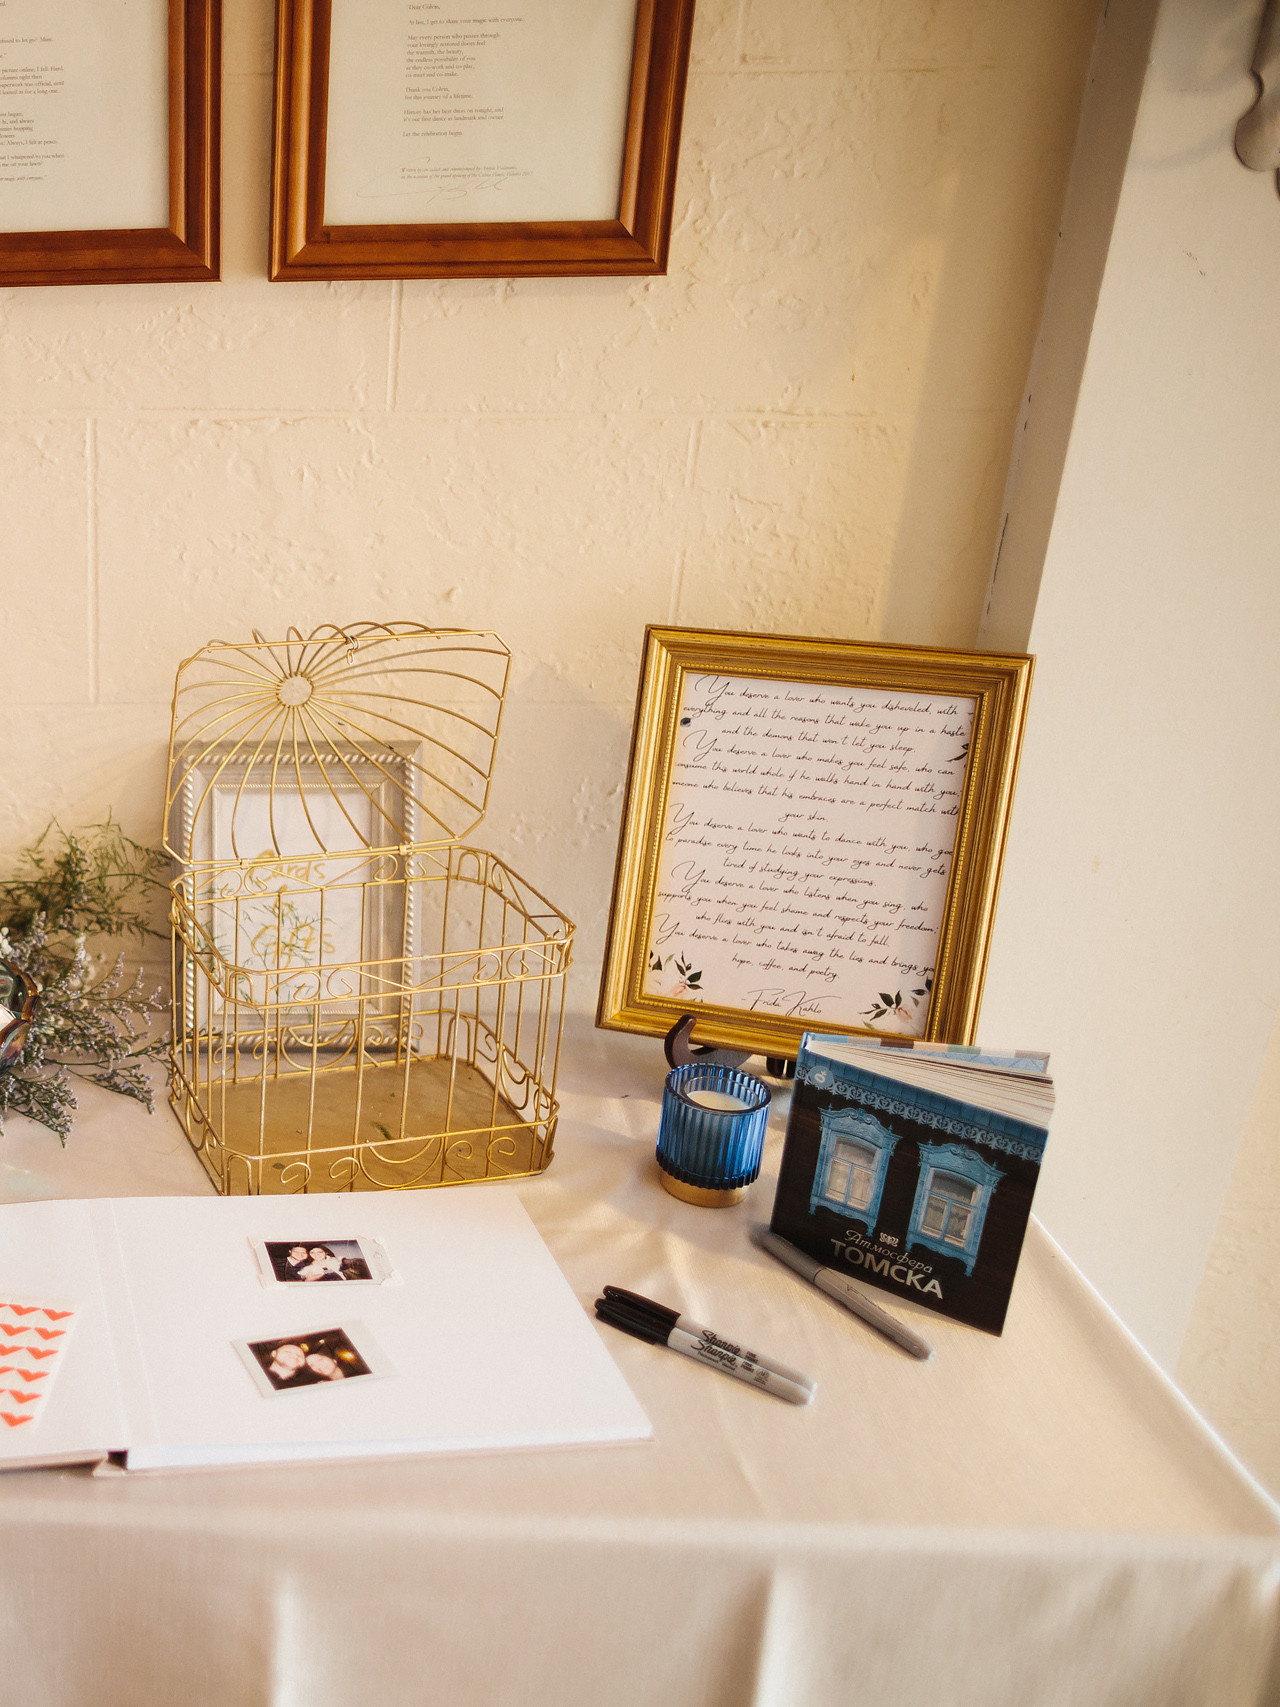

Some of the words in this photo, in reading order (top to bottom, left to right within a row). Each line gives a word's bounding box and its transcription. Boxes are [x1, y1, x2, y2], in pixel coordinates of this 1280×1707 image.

[694, 675, 735, 708] You
[739, 687, 770, 699] deserve
[784, 690, 804, 701] lover
[809, 693, 826, 704] who
[830, 696, 854, 708] wants
[853, 702, 875, 714] you
[881, 699, 932, 715] disheveled,
[936, 705, 958, 715] with
[683, 704, 728, 720] everything
[732, 706, 750, 716] and
[753, 708, 769, 719] all
[771, 710, 786, 720] the
[790, 715, 819, 724] reasons
[825, 713, 845, 726] that
[849, 717, 871, 728] wake
[868, 723, 893, 734] you
[897, 726, 910, 736] up
[940, 724, 966, 737] haste
[683, 729, 721, 762] You
[727, 744, 757, 756] deserve
[771, 748, 792, 759] lover
[796, 750, 813, 762] who
[816, 753, 843, 765] makes
[841, 760, 865, 771] you
[864, 757, 888, 770] feel
[889, 760, 910, 773] safe,
[915, 762, 933, 774] who
[937, 768, 956, 776] can
[721, 725, 742, 735] and
[743, 727, 758, 737] the
[762, 728, 793, 741] demons
[798, 732, 819, 743] that
[822, 733, 848, 745] won't
[852, 736, 866, 748] let
[863, 742, 887, 753] you
[889, 740, 916, 756] sleep.
[777, 812, 805, 822] your
[807, 810, 829, 823] skin.
[723, 857, 746, 869] tired
[748, 861, 758, 873] of
[759, 861, 799, 881] studying
[798, 873, 823, 882] your
[829, 875, 877, 887] expressions.
[658, 888, 692, 903] supports
[691, 894, 712, 906] you
[716, 895, 738, 906] when
[736, 902, 758, 912] you
[761, 900, 780, 913] feel
[781, 903, 809, 916] shame
[812, 909, 833, 919] and
[834, 912, 869, 926] respects
[866, 920, 894, 930] your
[894, 918, 939, 934] freedom;
[251, 922, 336, 969] Gifts
[695, 911, 711, 921] who
[712, 913, 732, 925] flies
[736, 916, 755, 927] with
[753, 924, 776, 934] you
[779, 923, 800, 933] and
[801, 926, 824, 936] isn't
[826, 929, 856, 941] afraid
[857, 932, 867, 943] to
[867, 935, 890, 947] fall.
[731, 952, 754, 968] hope,
[758, 958, 784, 971] coffee,
[788, 963, 808, 973] and
[806, 966, 840, 983] poetry.
[747, 988, 786, 1011] Frida
[781, 990, 842, 1017] Kahlo
[830, 1237, 944, 1300] ТОМСКА
[846, 1229, 934, 1275] Атмосфера
[690, 1340, 737, 1366] Sharpie
